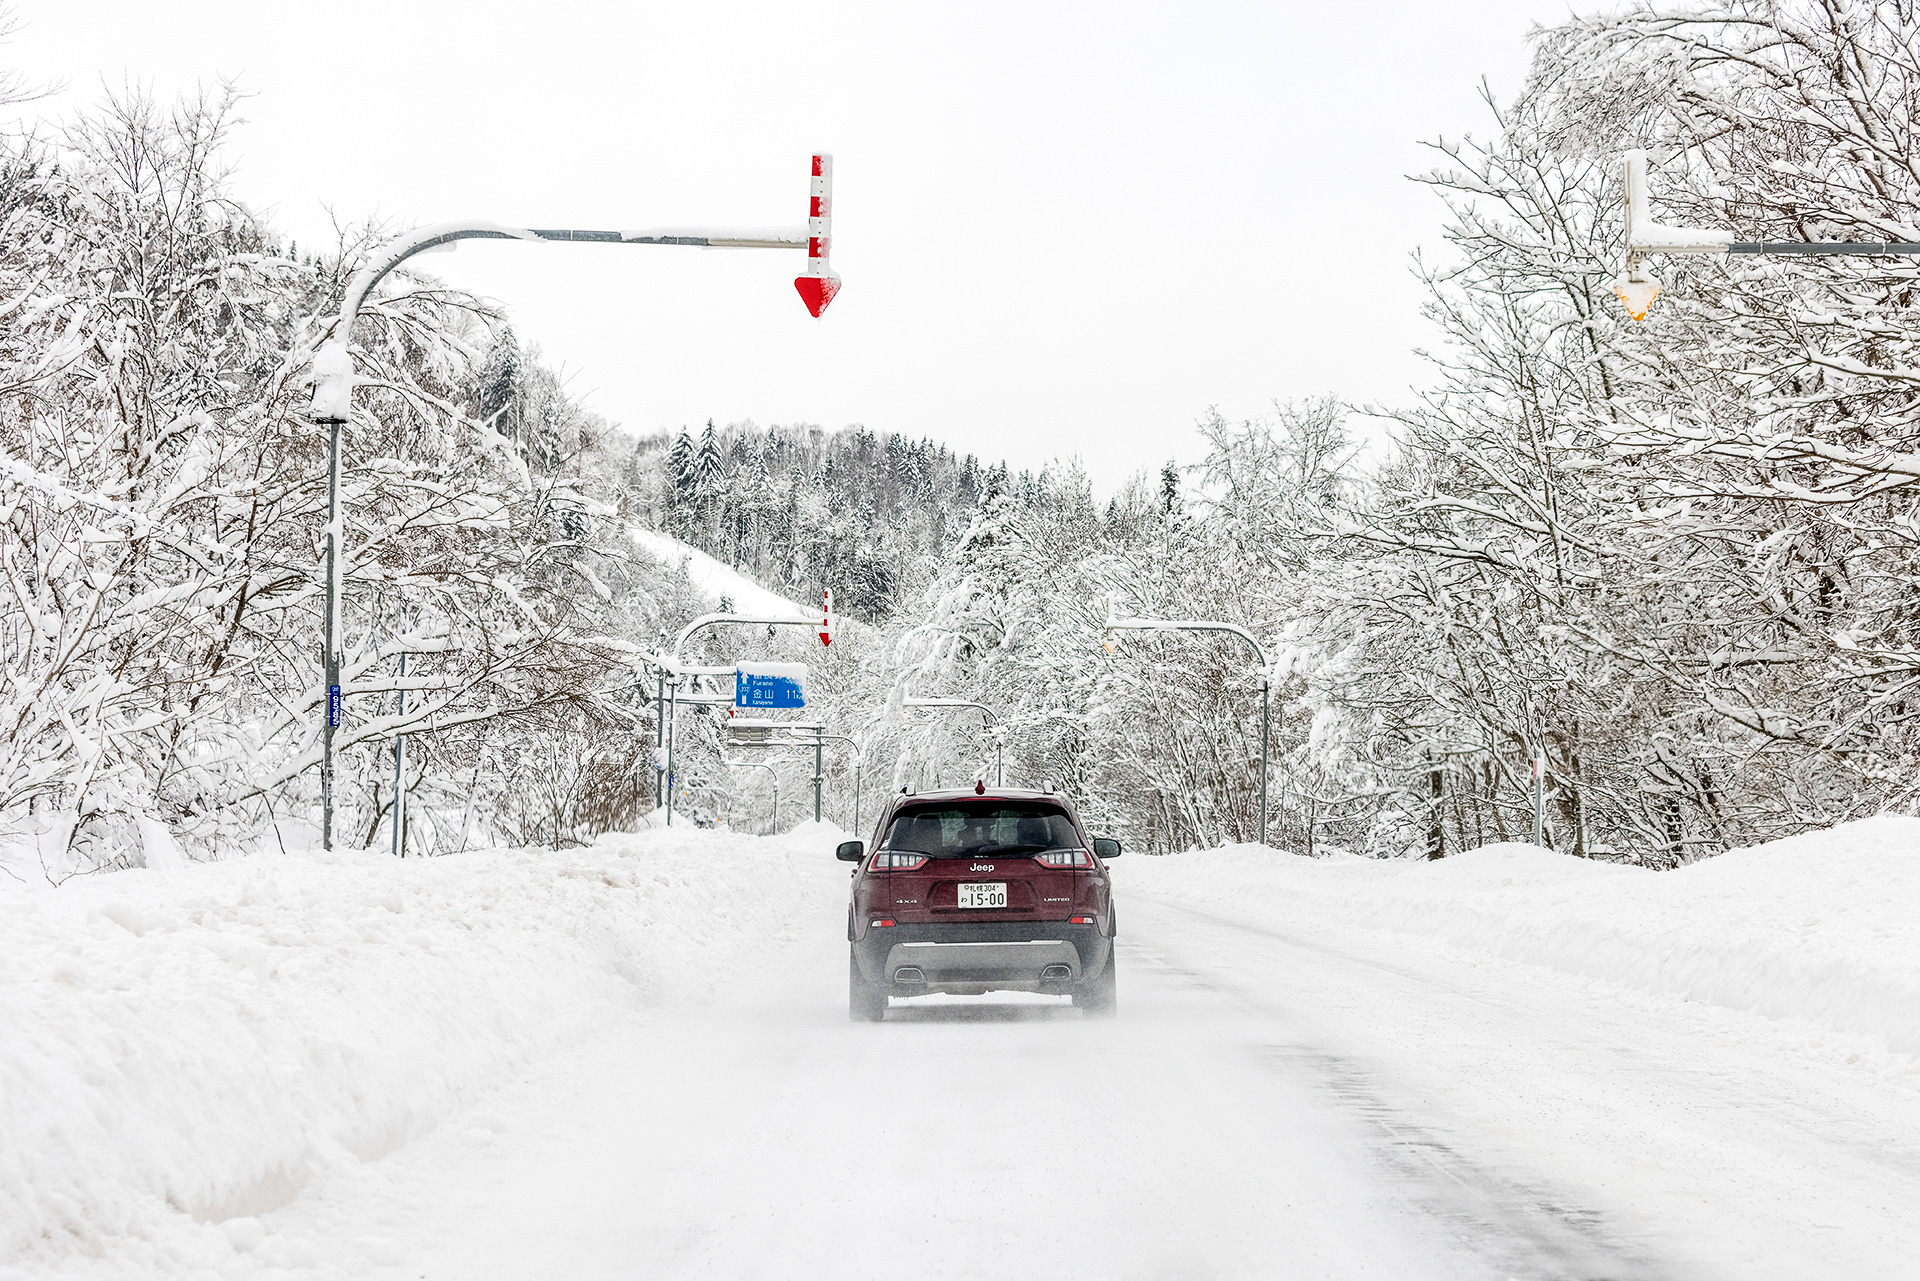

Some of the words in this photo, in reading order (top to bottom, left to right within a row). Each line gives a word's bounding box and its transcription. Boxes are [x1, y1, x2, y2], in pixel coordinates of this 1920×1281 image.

[753, 688, 774, 699] 金山
[969, 862, 995, 873] Jeep
[970, 893, 1005, 906] 15-00
